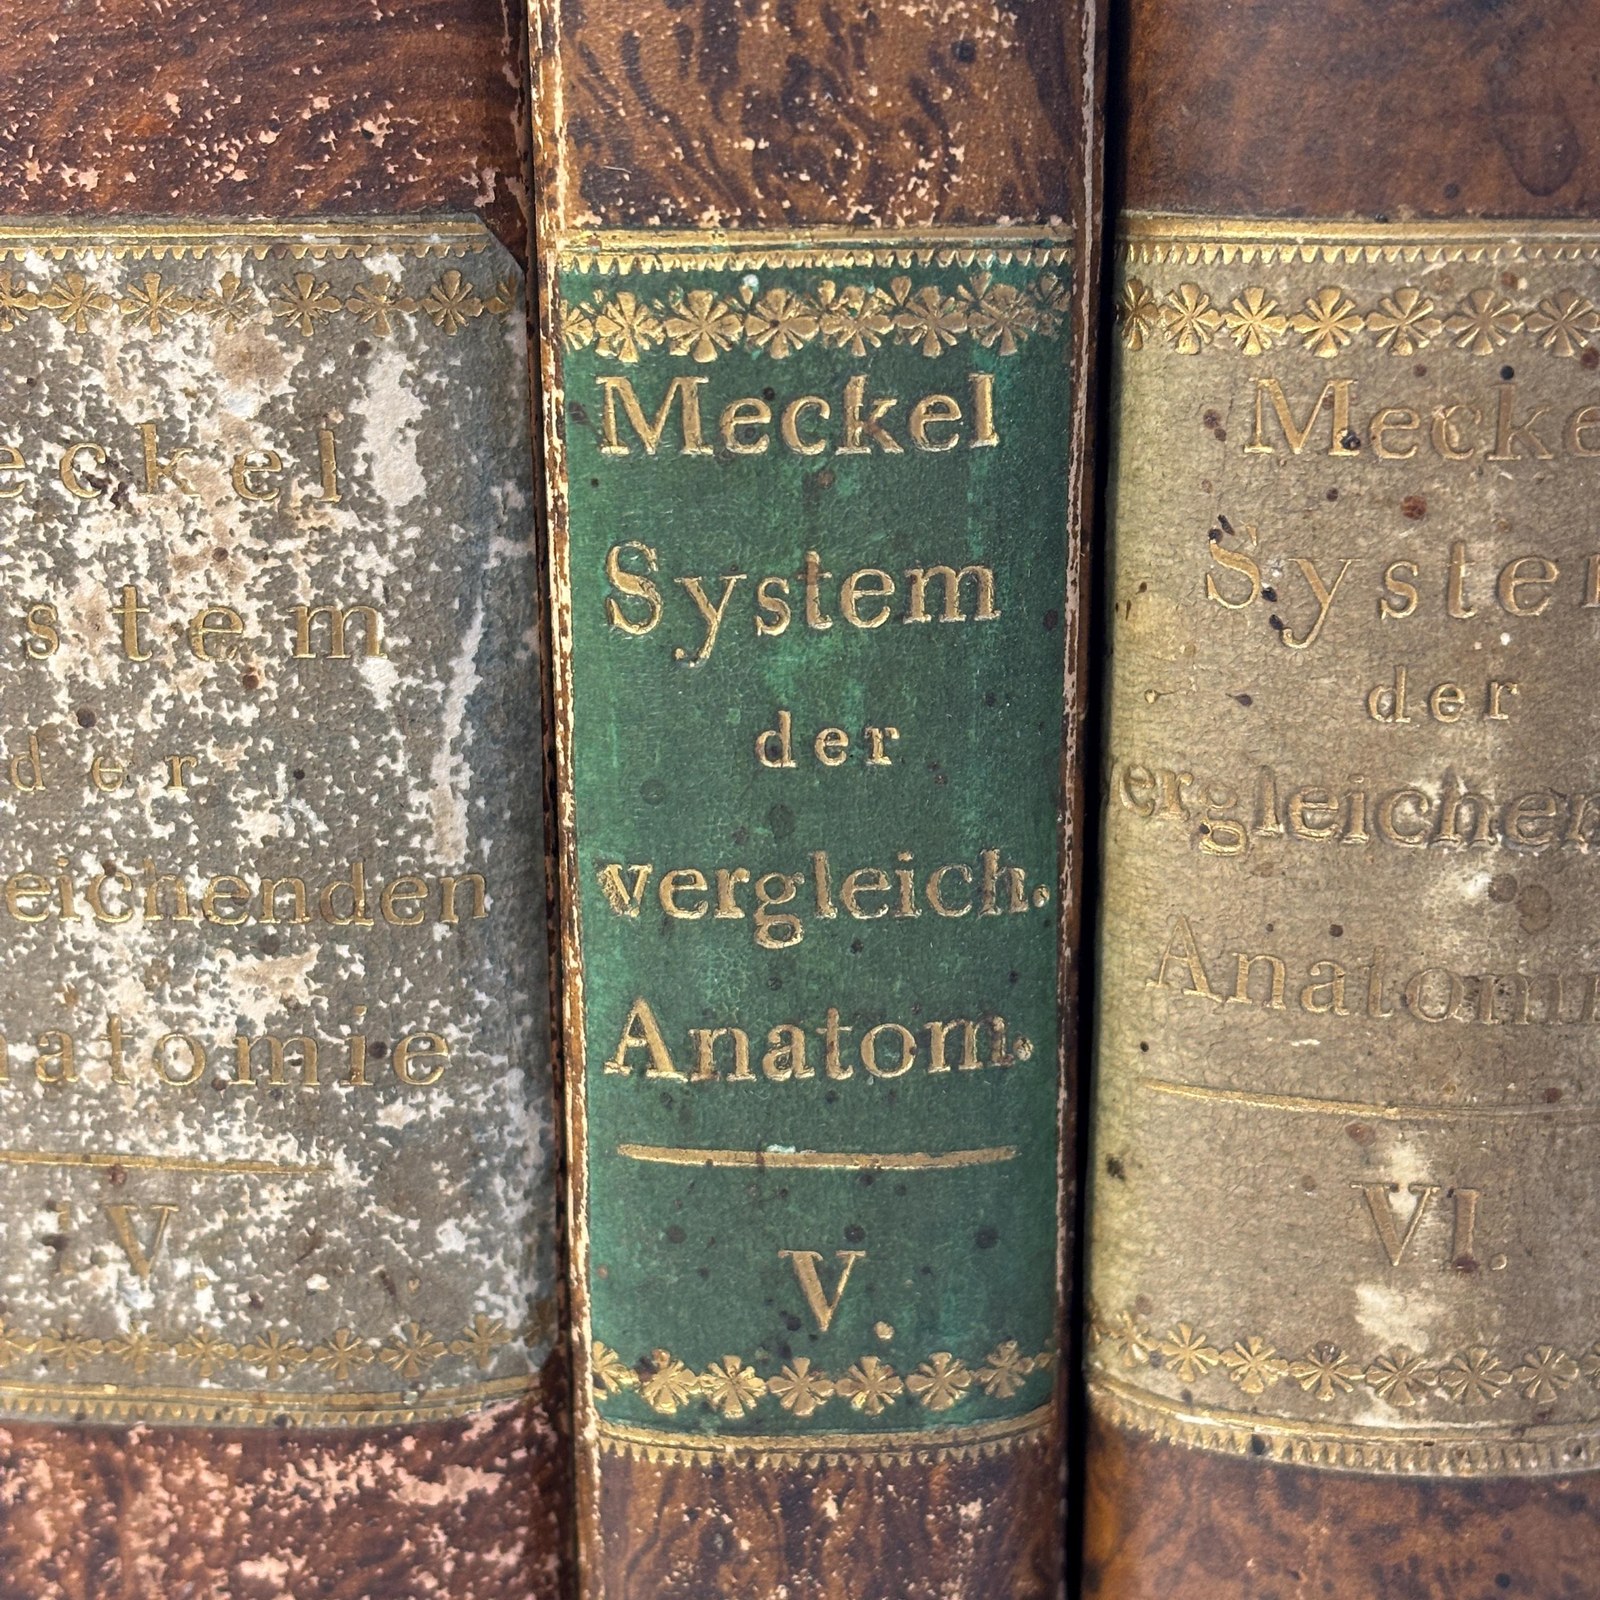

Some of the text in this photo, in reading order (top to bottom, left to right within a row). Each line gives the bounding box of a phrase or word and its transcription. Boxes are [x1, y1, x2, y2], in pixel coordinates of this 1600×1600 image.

[596, 373, 1000, 456] Meckel
[606, 540, 1000, 667] System
[1368, 664, 1519, 724] der
[10, 734, 197, 793] der
[755, 711, 900, 768] der
[597, 848, 1050, 949] vergleich.
[604, 998, 1034, 1083] Anatom.
[1350, 1182, 1508, 1274] VI.
[778, 1250, 896, 1341] V.
